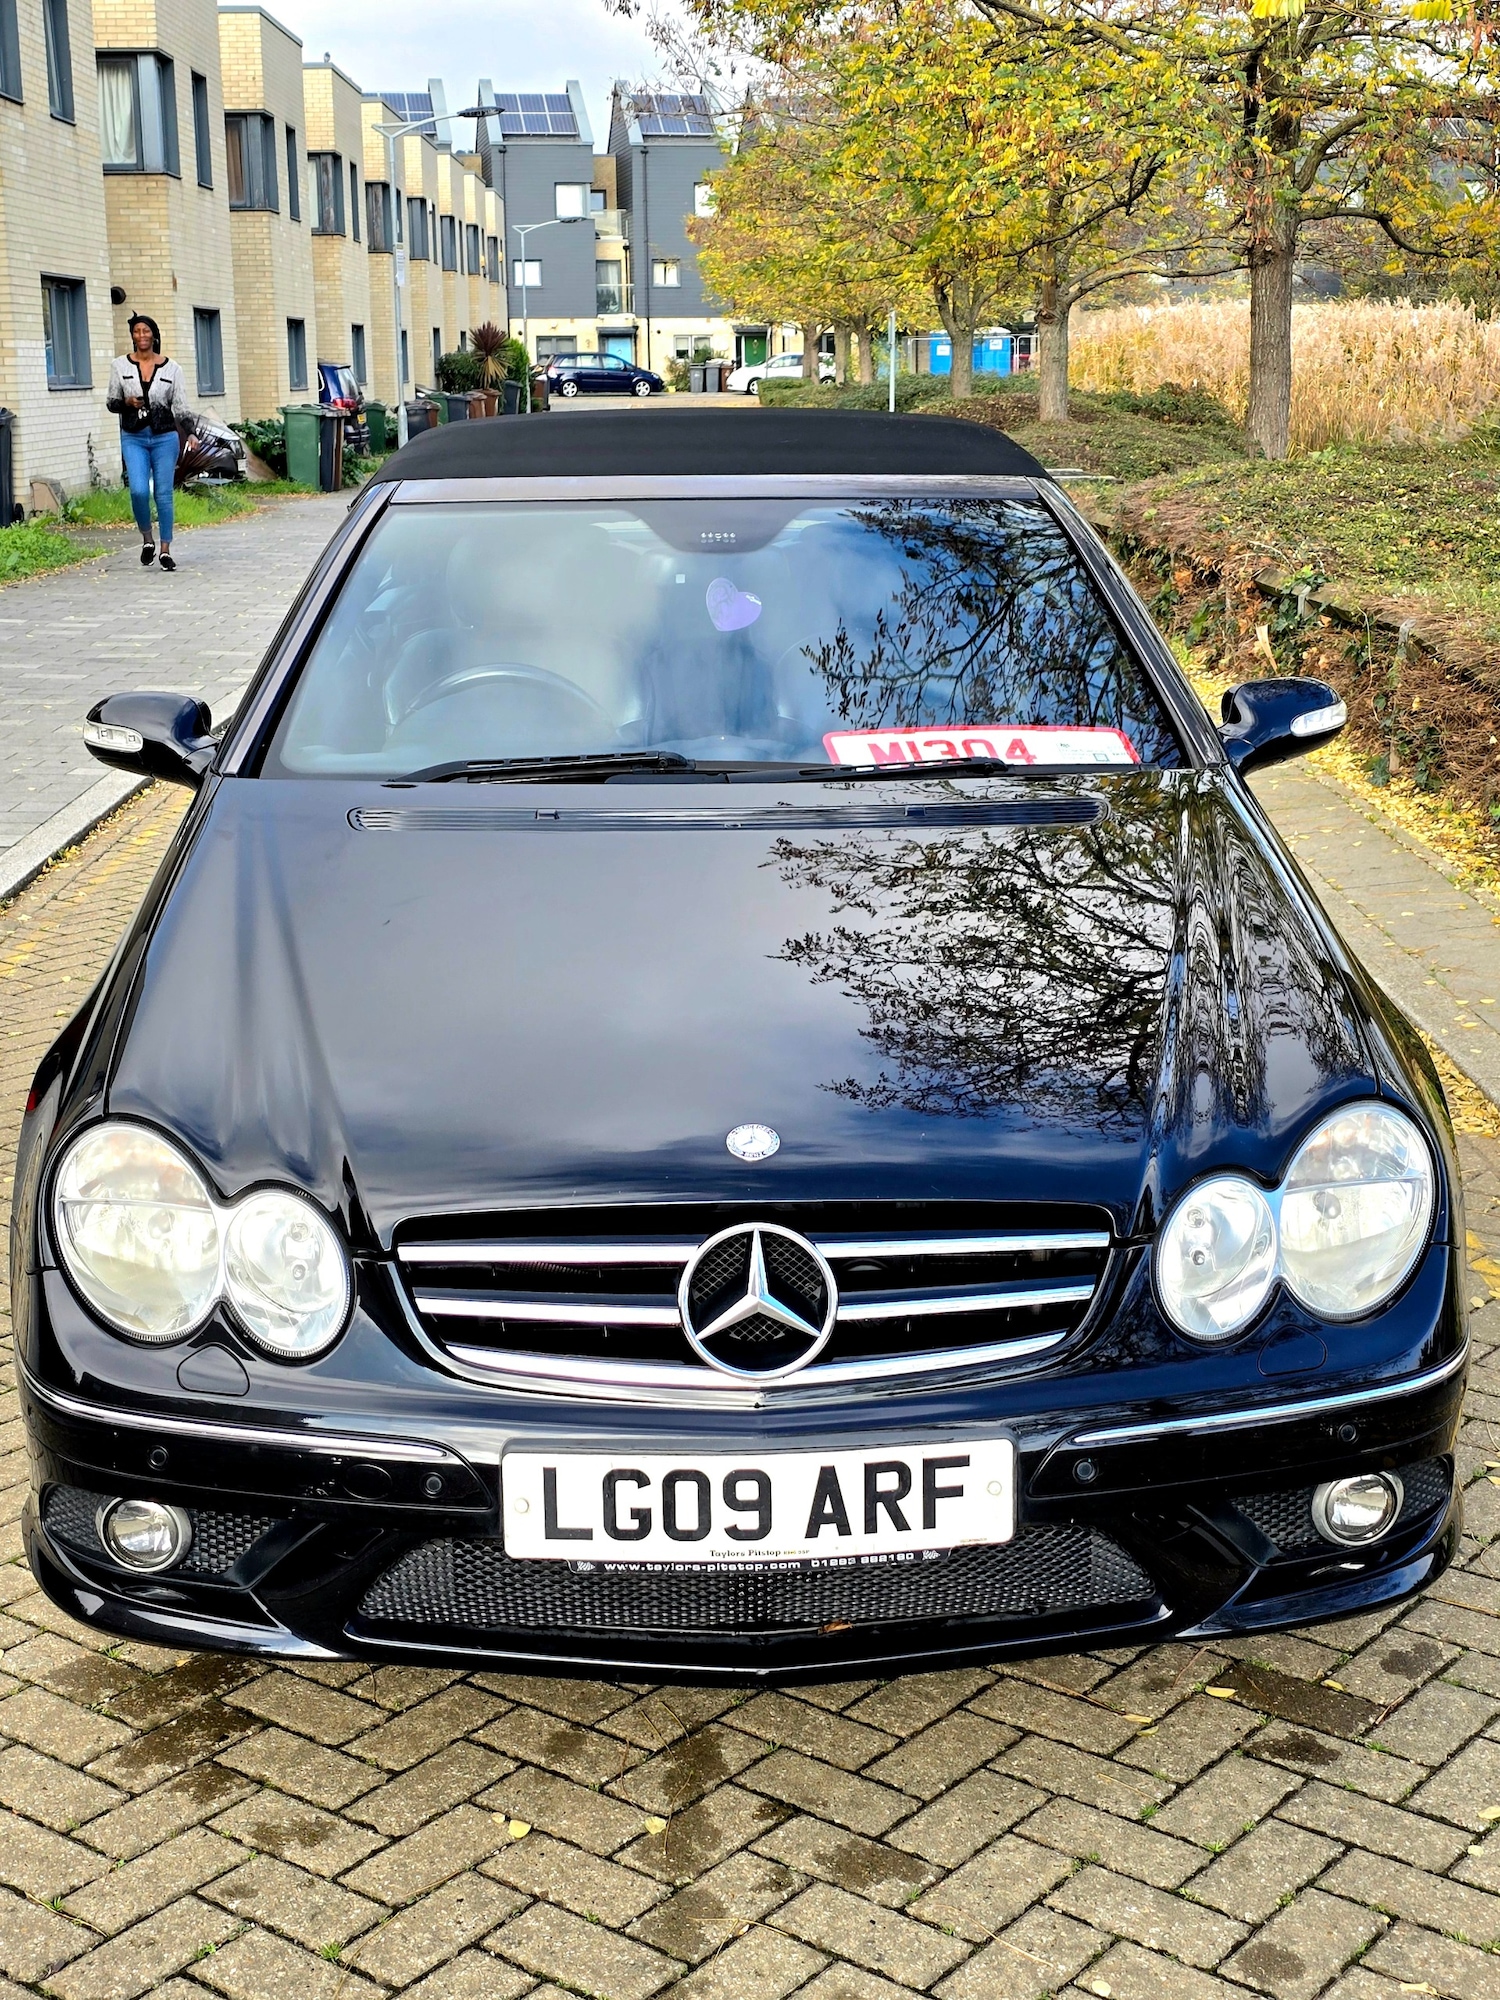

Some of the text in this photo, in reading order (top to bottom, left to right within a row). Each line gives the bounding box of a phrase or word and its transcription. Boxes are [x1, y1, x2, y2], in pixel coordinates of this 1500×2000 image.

[543, 1454, 971, 1541] LG09 ARF
[709, 1549, 746, 1559] Taylors
[748, 1549, 781, 1557] Pitstop
[604, 1561, 801, 1573] www.taylors-pitstop.com
